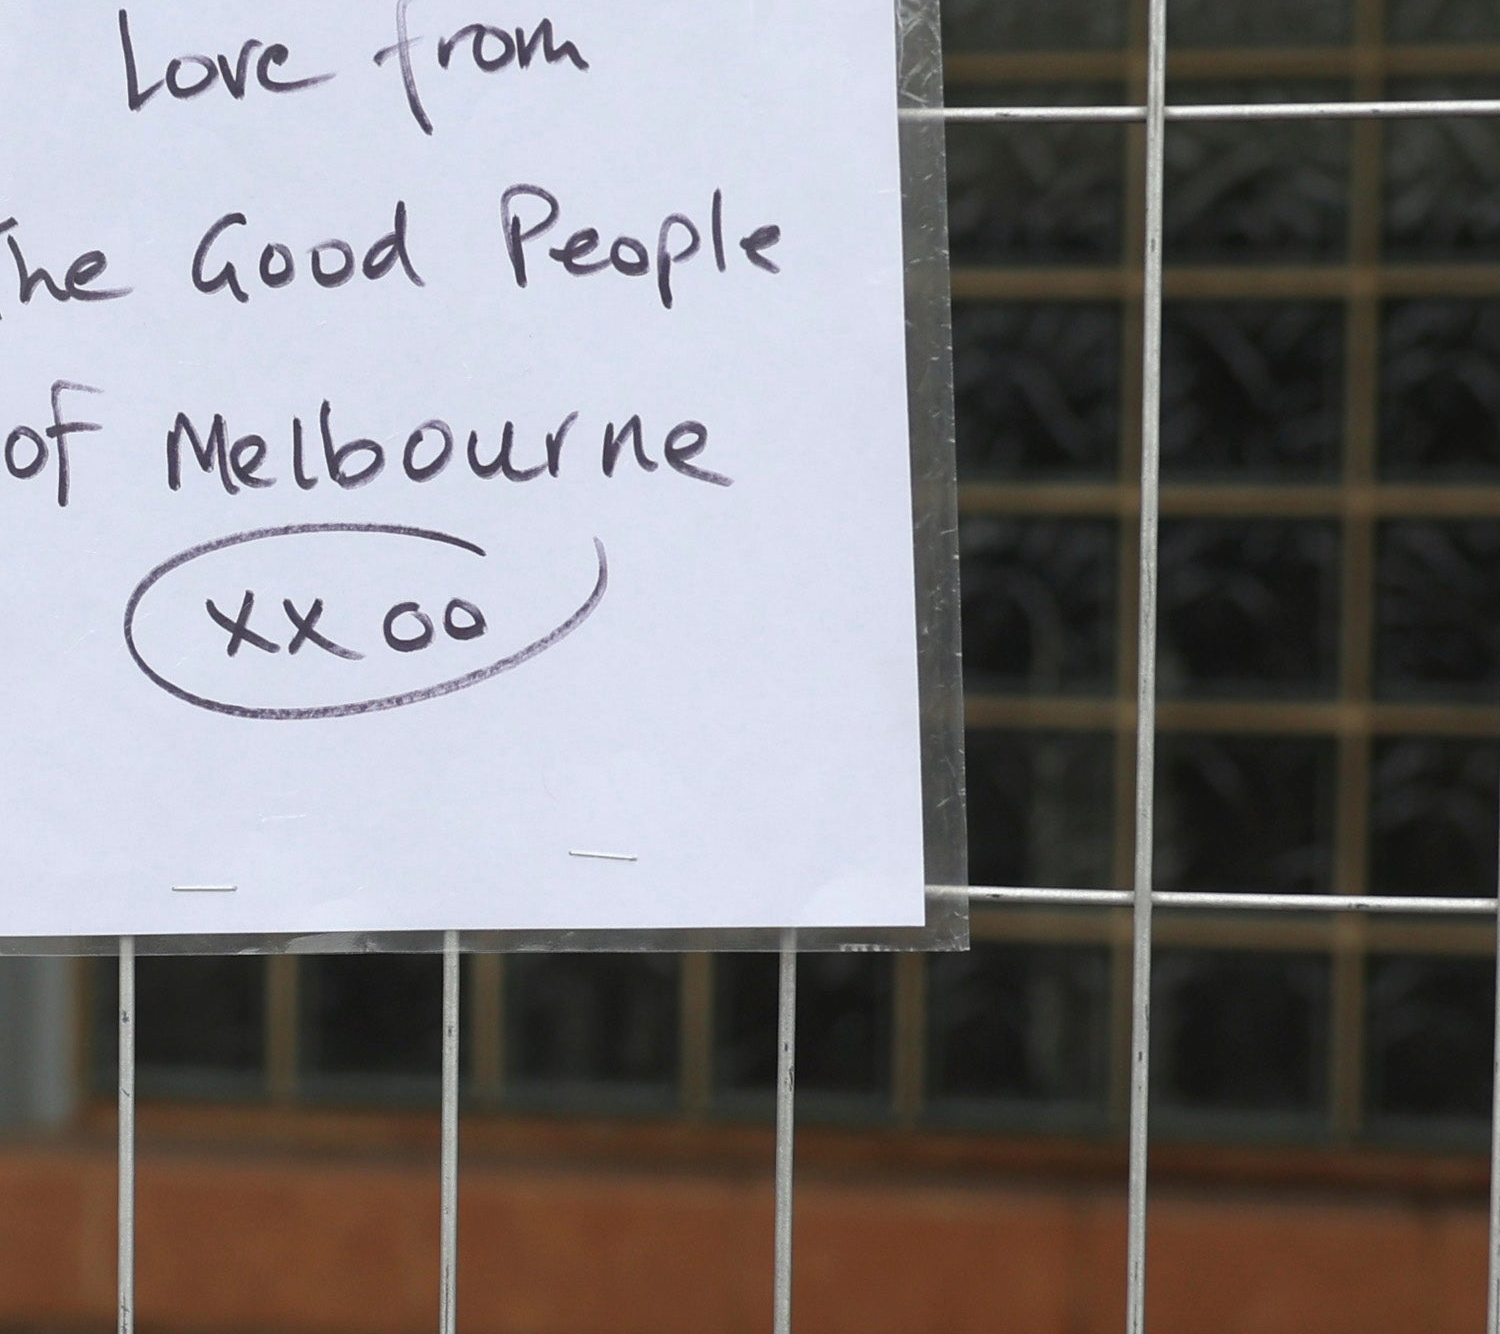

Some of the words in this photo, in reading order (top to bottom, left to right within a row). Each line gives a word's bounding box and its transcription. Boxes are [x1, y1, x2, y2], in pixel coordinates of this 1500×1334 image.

[191, 200, 426, 304] Good
[500, 183, 782, 310] People
[4, 379, 104, 508] of
[166, 398, 734, 496] Melbourne
